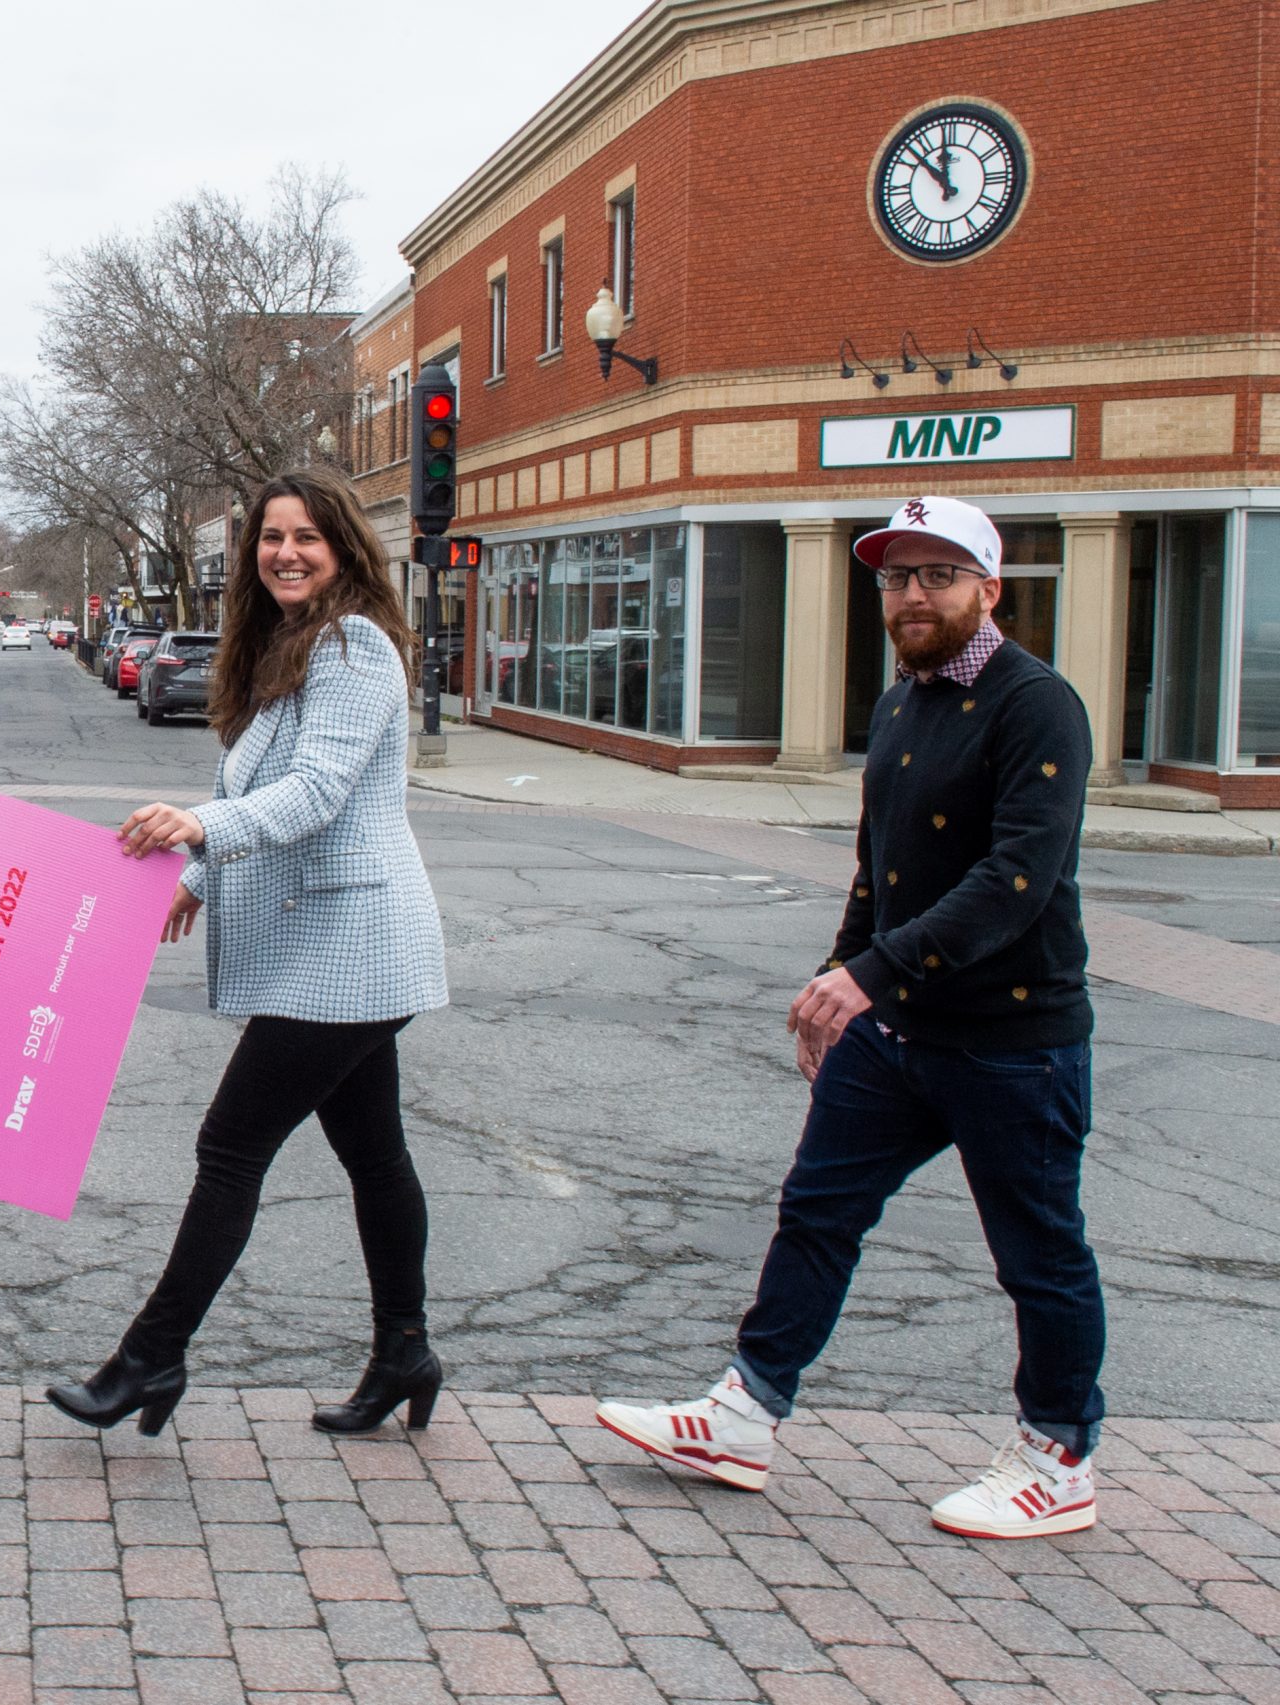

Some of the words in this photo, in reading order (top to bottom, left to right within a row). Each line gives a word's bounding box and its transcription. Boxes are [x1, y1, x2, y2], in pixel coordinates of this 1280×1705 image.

[887, 415, 1002, 459] MNP
[49, 953, 69, 993] Produit
[63, 934, 75, 953] par
[5, 1075, 36, 1132] Drav
